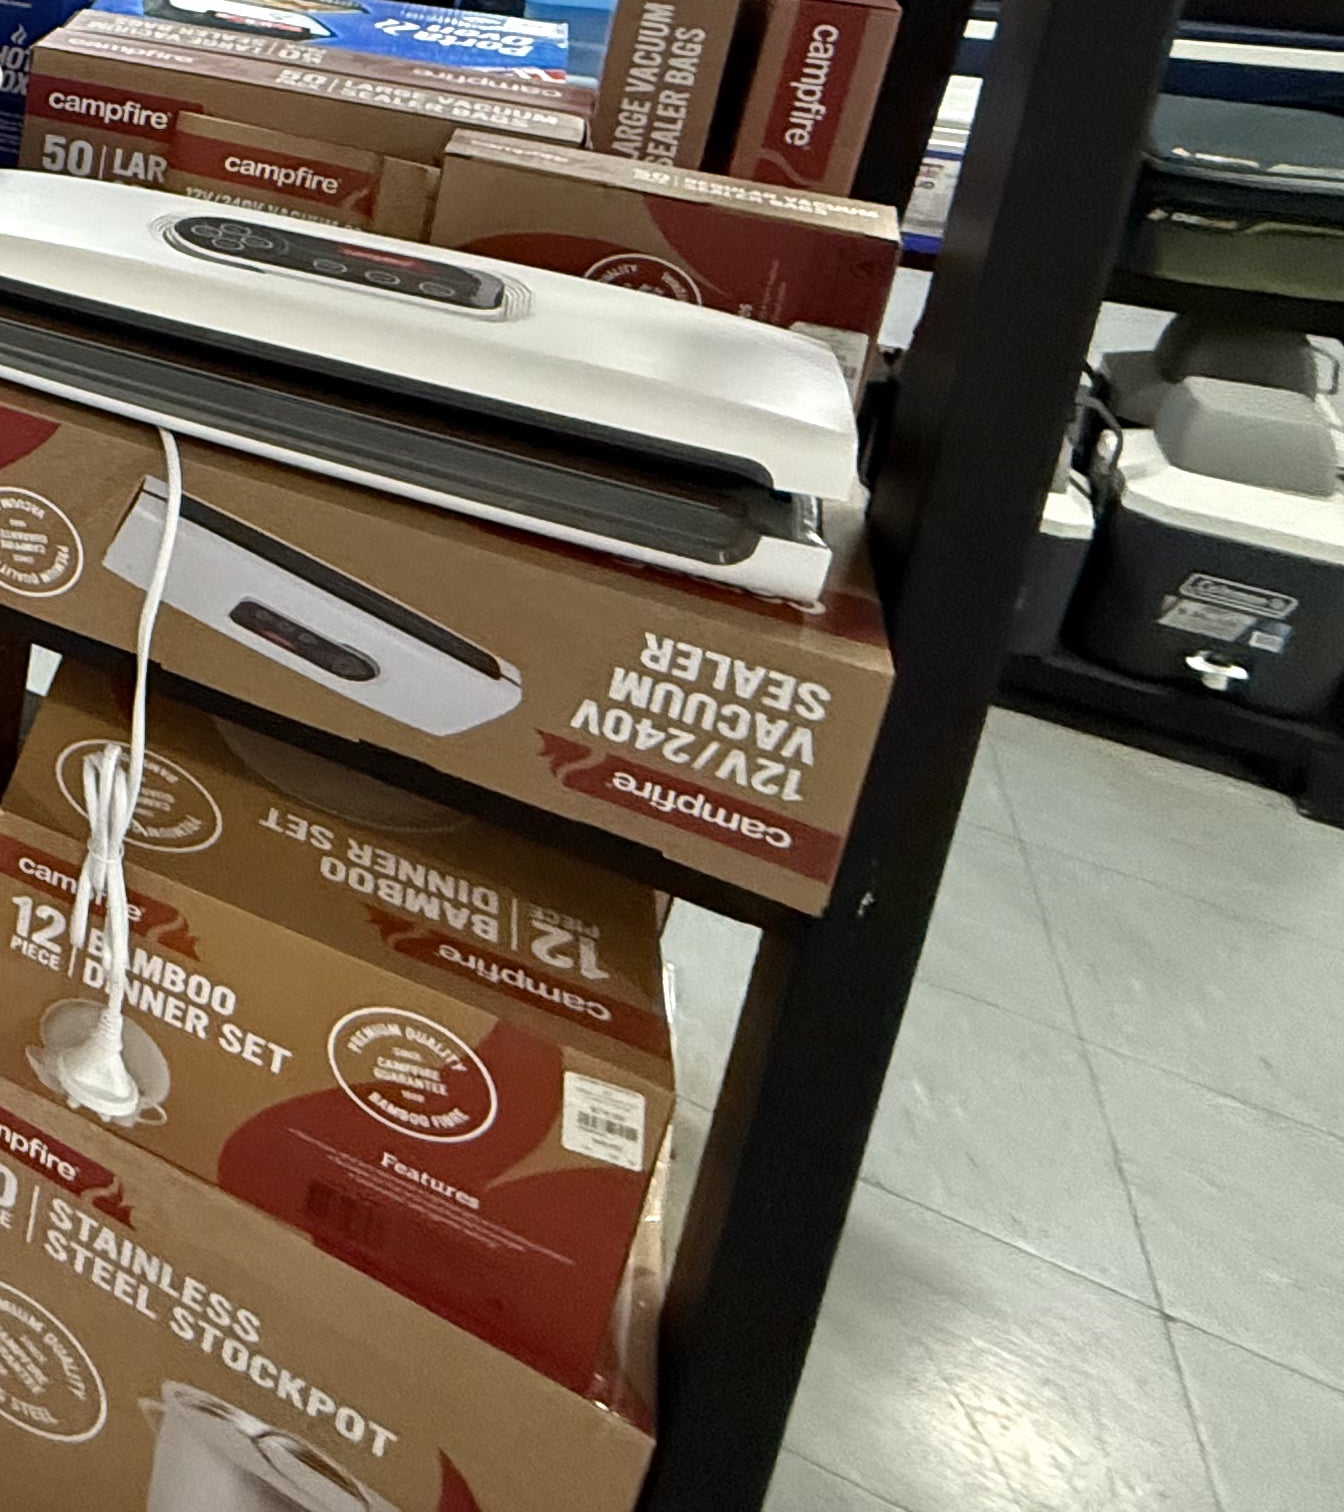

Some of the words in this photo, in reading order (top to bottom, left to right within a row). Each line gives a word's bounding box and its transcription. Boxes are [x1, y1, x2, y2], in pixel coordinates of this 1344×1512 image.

[68, 37, 193, 63] campfire
[413, 30, 534, 57] Porta
[625, 2, 676, 92] VACUUM
[664, 26, 707, 87] BAGS
[2, 70, 29, 96] OX
[48, 92, 169, 130] campfire
[345, 79, 429, 100] LARGE
[438, 95, 560, 125] VACUUM
[412, 68, 562, 98] campfire
[784, 23, 840, 147] campfire
[42, 134, 94, 176] 50
[612, 98, 652, 160] ARGE
[224, 156, 339, 194] campfire
[640, 631, 832, 721] SEALER
[608, 666, 814, 767] VACUUM
[570, 698, 804, 803] 12V/240V
[258, 807, 335, 852] SET
[612, 771, 792, 849] campfire
[319, 855, 499, 943] BAMBOO
[347, 837, 499, 914] DINNER
[10, 935, 61, 972] PIECE
[12, 895, 66, 954] 12
[530, 918, 610, 980] 12
[88, 928, 237, 1017] BMBOO
[437, 943, 612, 1021] campfire
[82, 959, 209, 1040] DNNER
[218, 1023, 293, 1075] SET
[347, 1023, 402, 1054] PREMIUM
[405, 1026, 468, 1072] QUALITY
[376, 1056, 442, 1082] CAMPFIRE
[368, 1091, 430, 1128] BAMBOO
[431, 1107, 471, 1129] FIBRE
[373, 1066, 449, 1096] GUARANTEE
[380, 1151, 481, 1210] Features
[49, 1196, 262, 1344] STAINLESS
[43, 1228, 158, 1320] STEEL
[170, 1306, 399, 1458] STOCKPOT
[43, 1332, 87, 1401] QUALITY
[11, 1395, 59, 1424] STEEL
